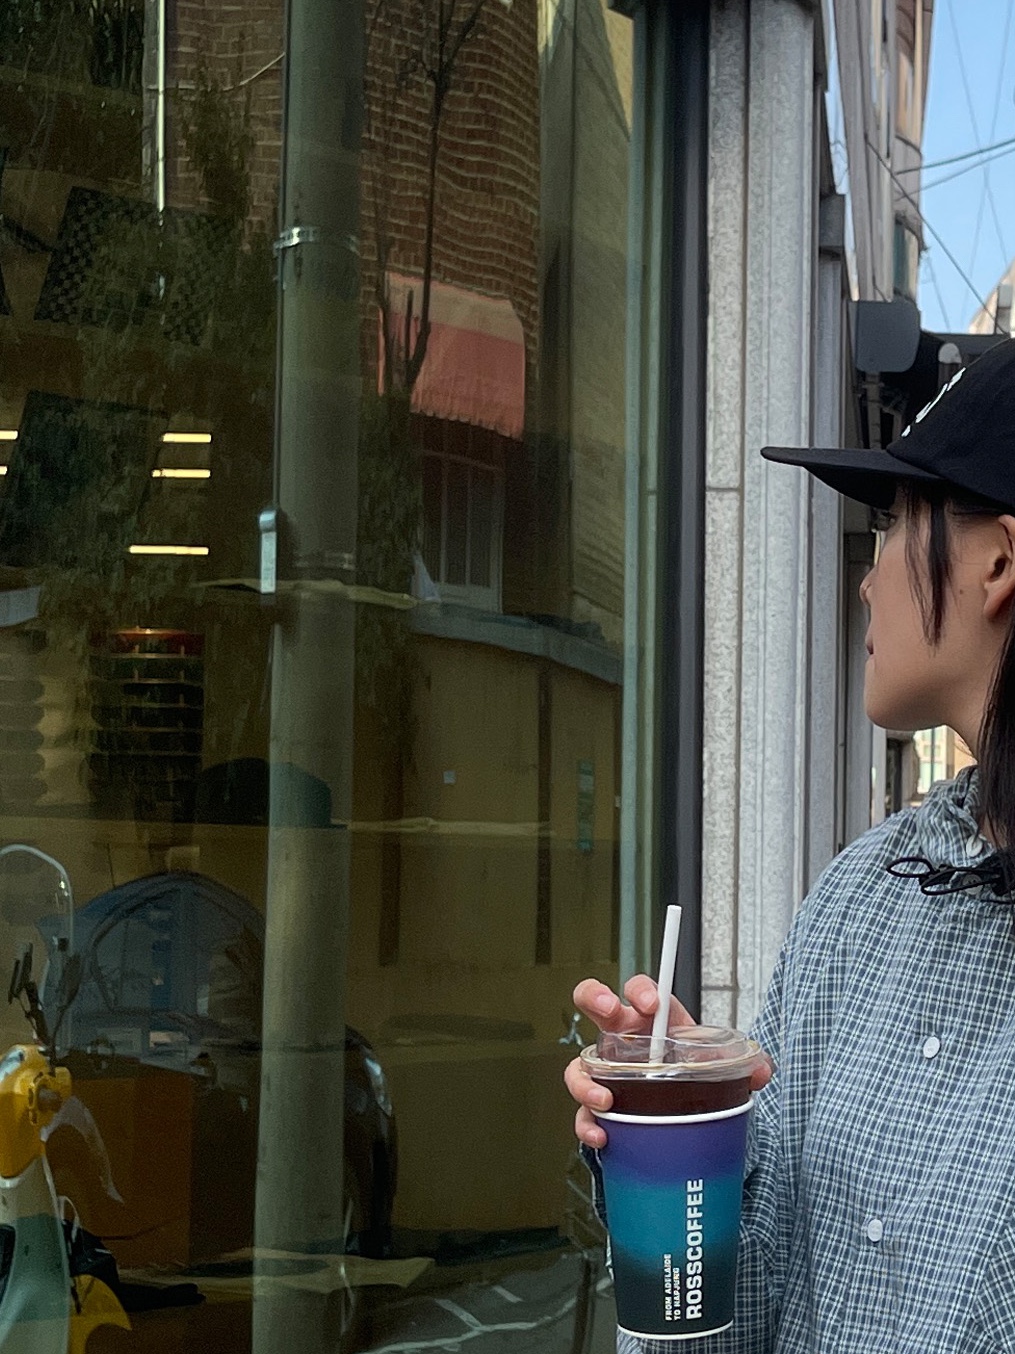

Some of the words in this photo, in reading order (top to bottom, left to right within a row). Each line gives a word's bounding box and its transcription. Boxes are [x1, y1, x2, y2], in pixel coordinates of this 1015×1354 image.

[686, 1179, 704, 1320] ROSSCOFFEE
[664, 1254, 672, 1294] ADELAIDE
[673, 1310, 681, 1321] TO
